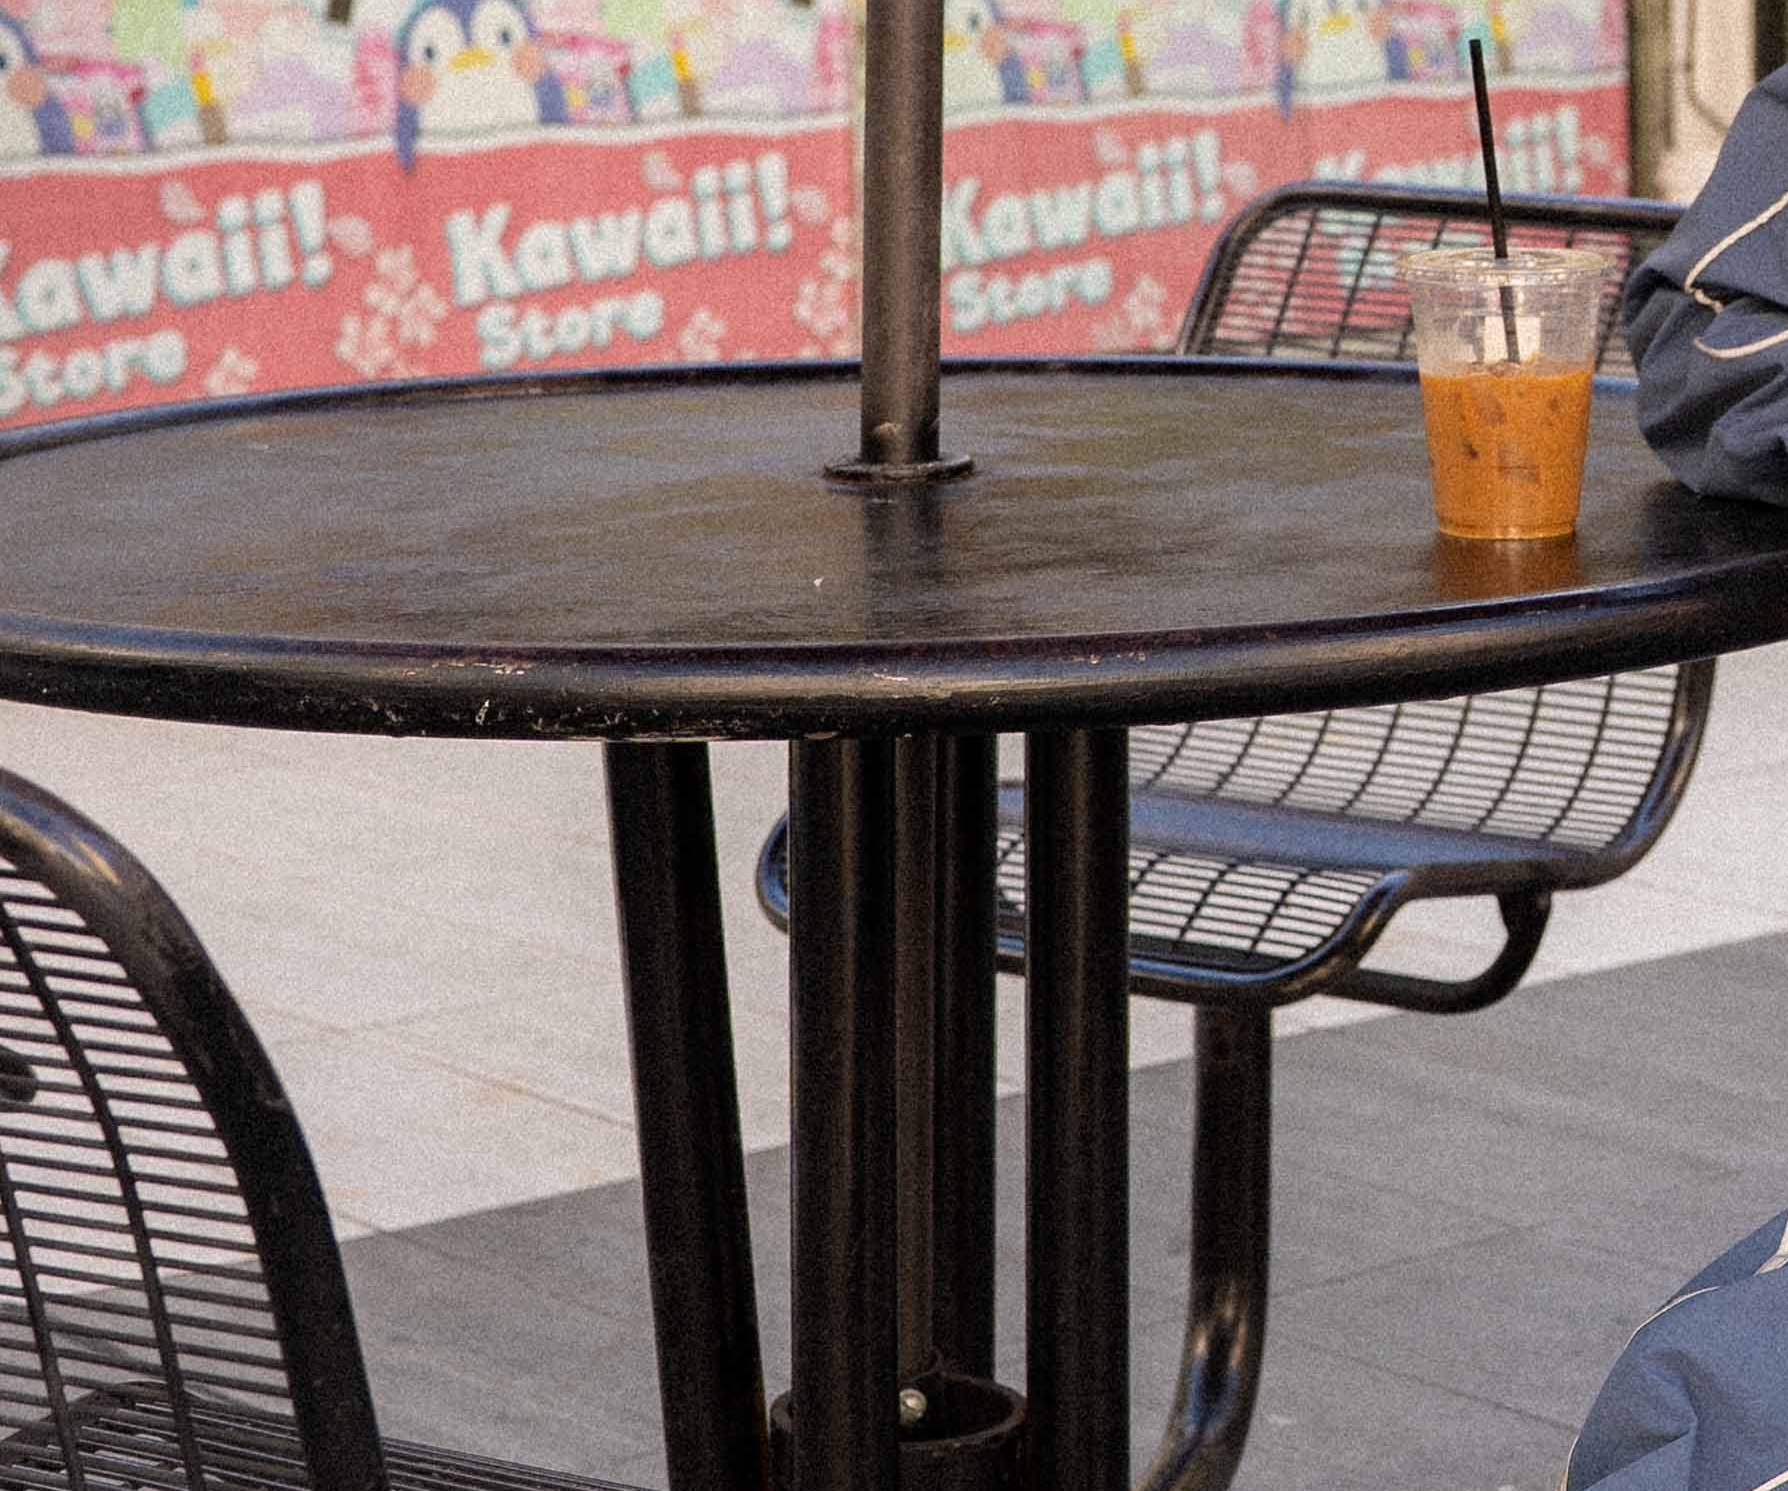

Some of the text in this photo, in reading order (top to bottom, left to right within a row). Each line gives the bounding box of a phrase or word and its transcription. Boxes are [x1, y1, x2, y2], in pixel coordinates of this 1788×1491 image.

[0, 180, 335, 343] awaii!
[444, 152, 792, 307] Kawaii!
[942, 127, 1226, 271] Kawaii!
[476, 290, 665, 370] Store
[949, 257, 1113, 334] Store
